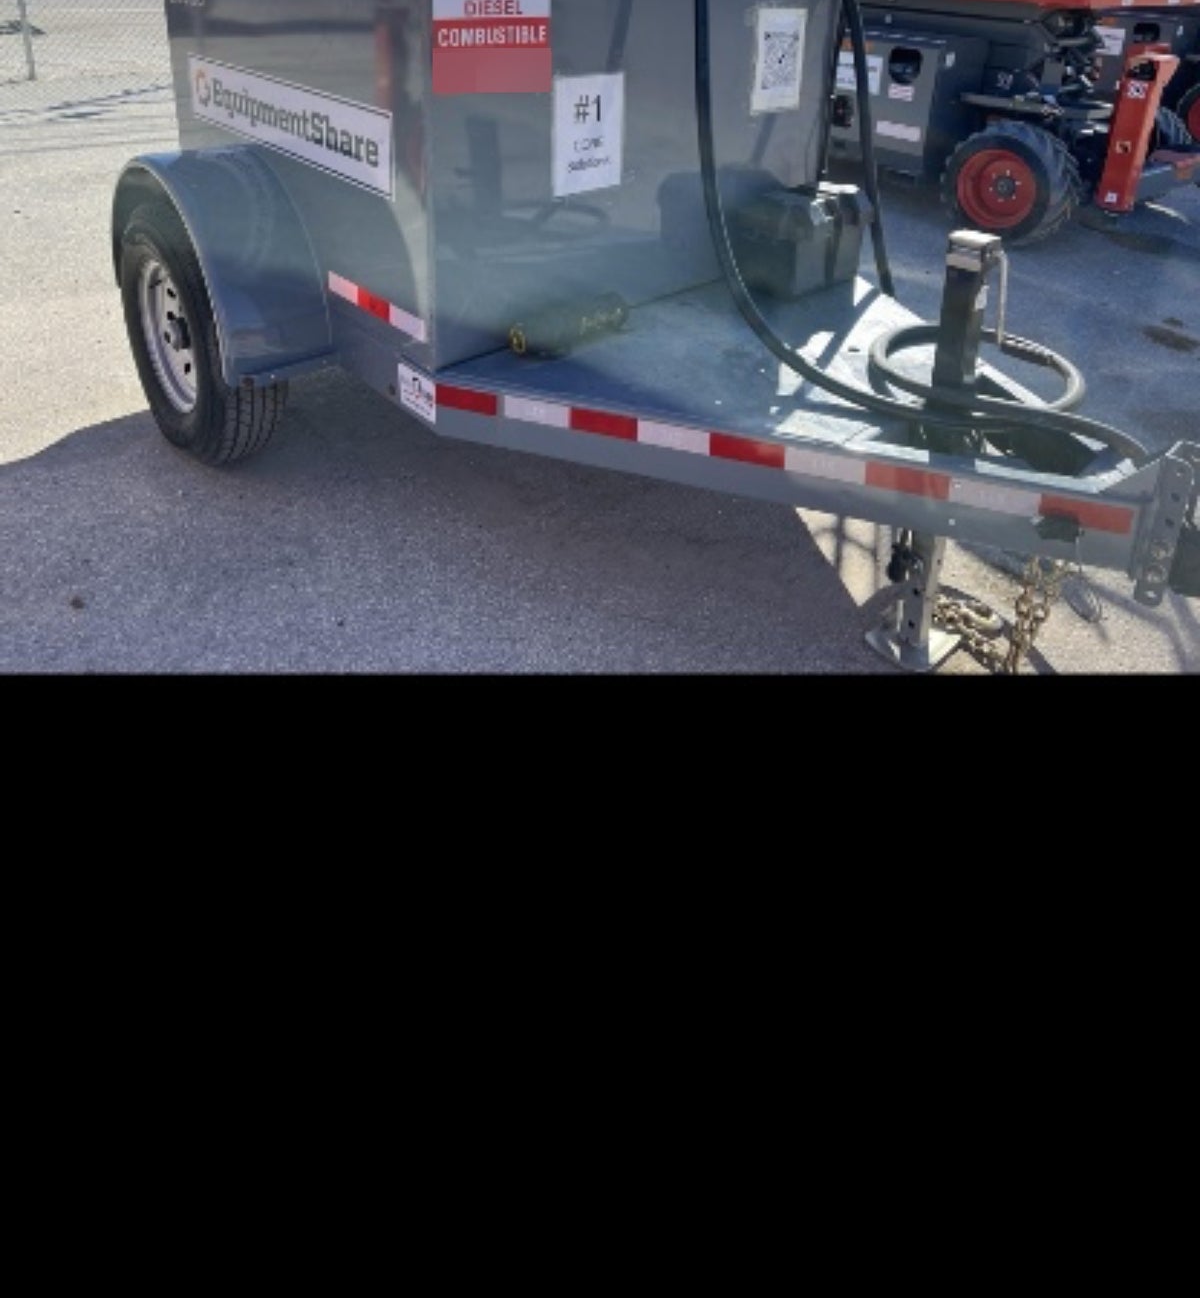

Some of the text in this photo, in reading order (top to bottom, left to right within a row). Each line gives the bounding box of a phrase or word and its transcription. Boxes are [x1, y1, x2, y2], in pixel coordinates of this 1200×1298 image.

[463, 0, 523, 16] DIESEL
[437, 25, 548, 48] COMBUSTIBLE
[211, 75, 379, 168] EquipmentShare
[573, 94, 601, 123] #1
